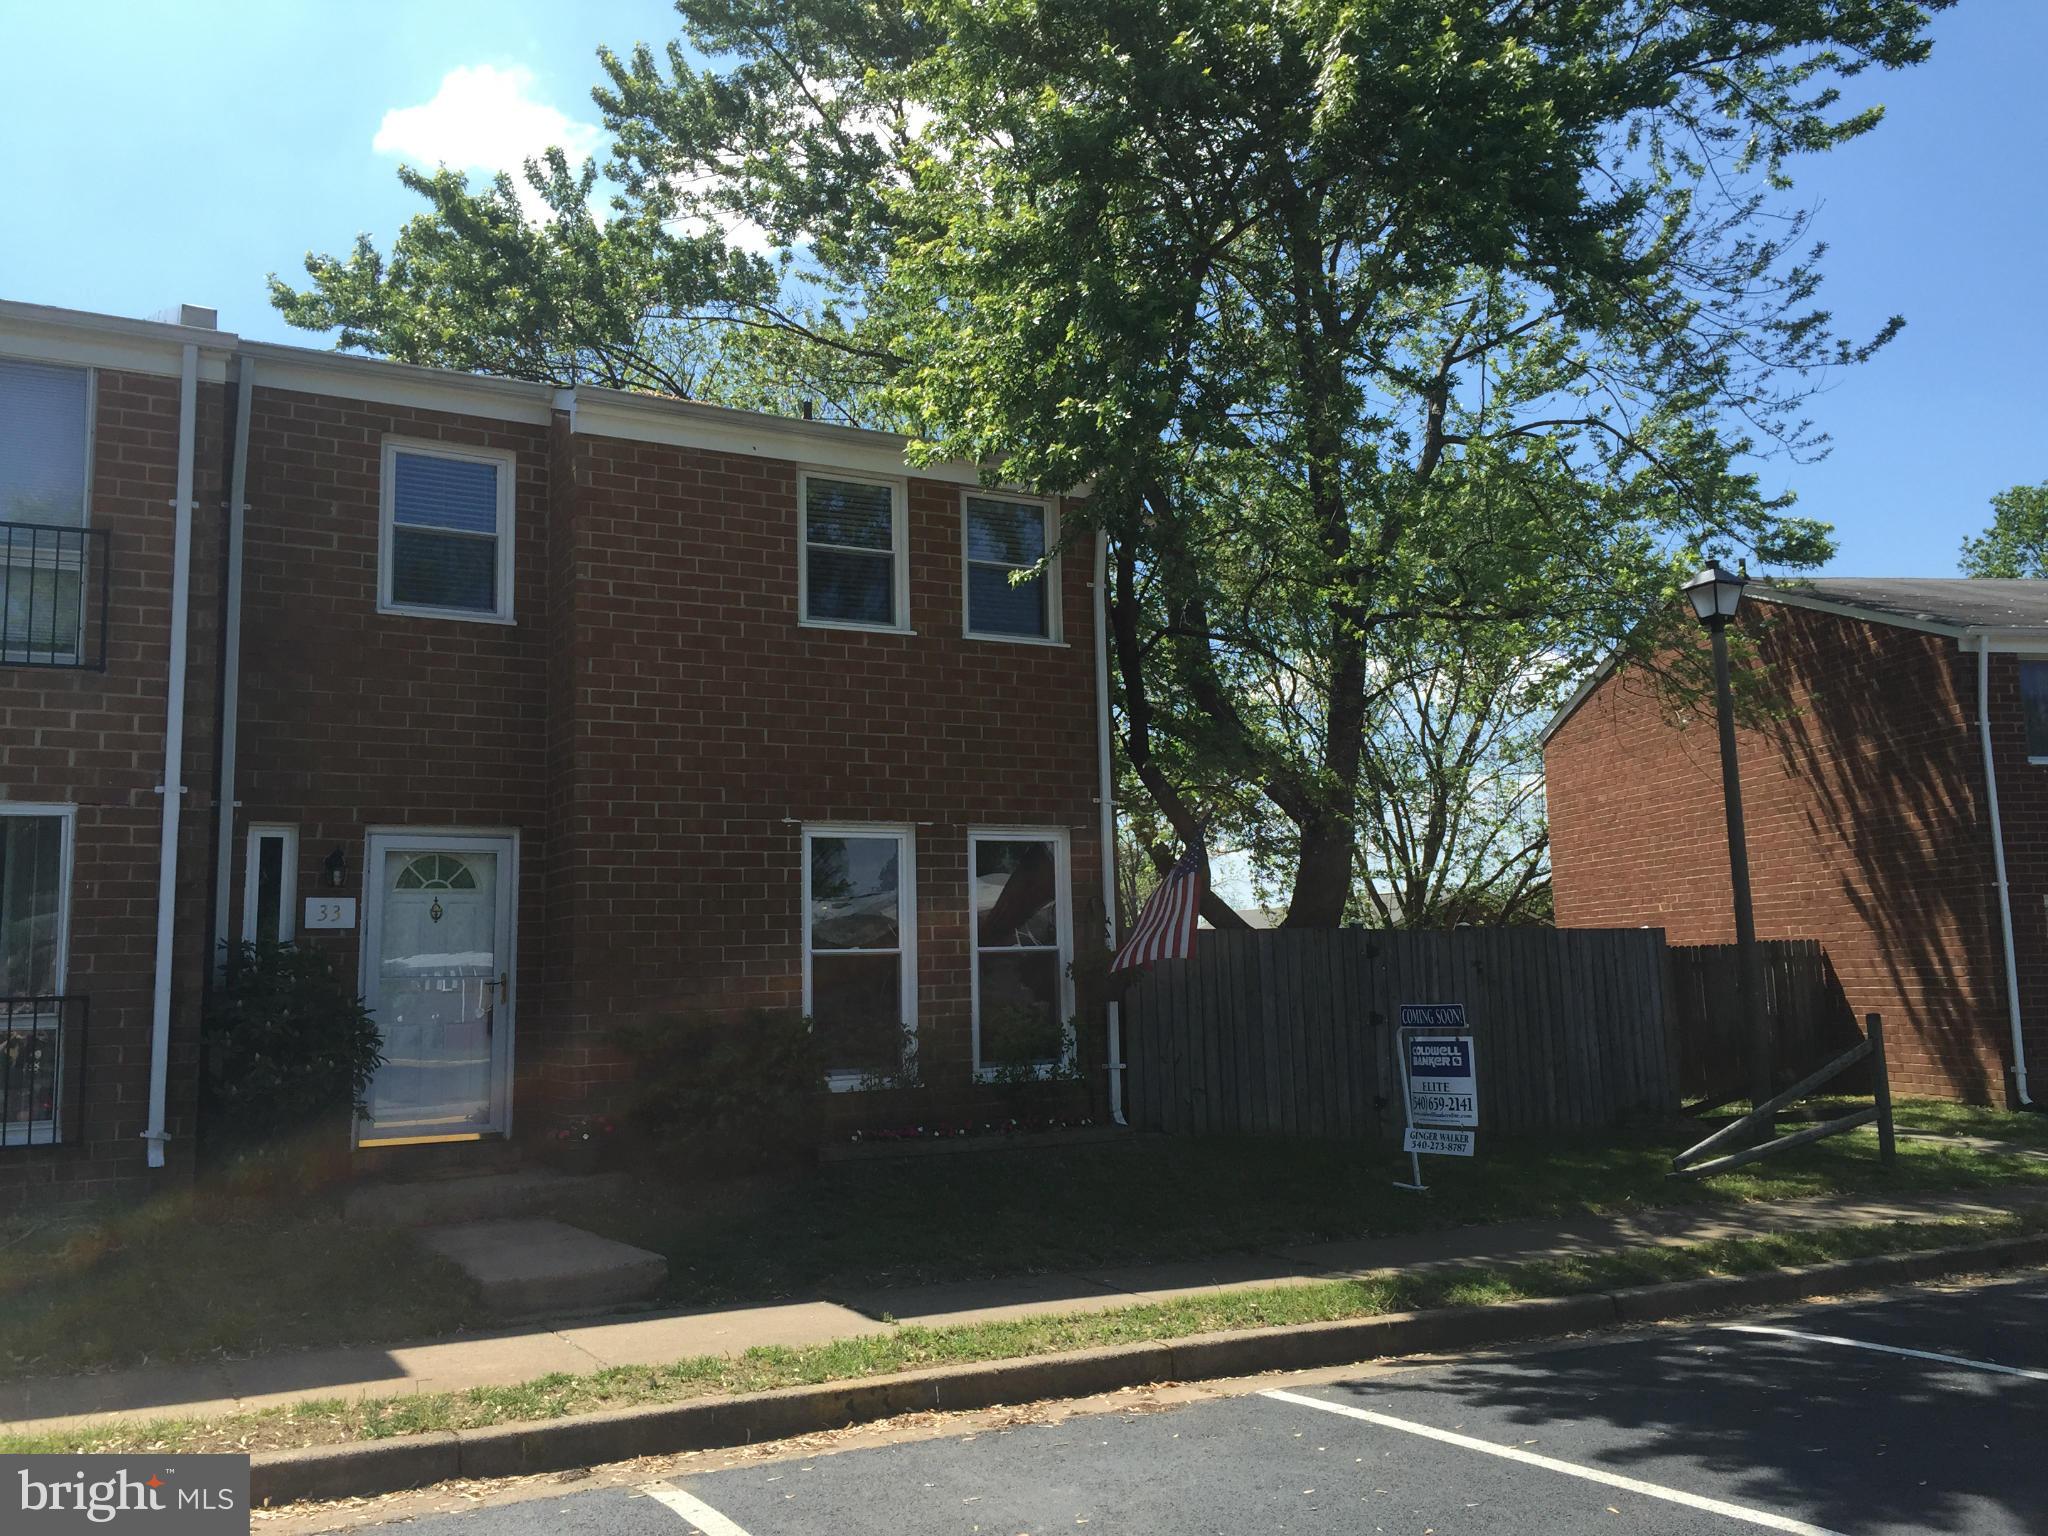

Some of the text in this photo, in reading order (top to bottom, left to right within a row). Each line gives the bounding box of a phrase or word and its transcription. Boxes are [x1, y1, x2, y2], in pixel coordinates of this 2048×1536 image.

[317, 904, 341, 922] 33
[1402, 1008, 1463, 1024] COMING SOON!
[1422, 1082, 1450, 1092] ELITE
[1409, 1131, 1469, 1144] GINGER WALKER
[1411, 1141, 1467, 1152] 540-273-8787
